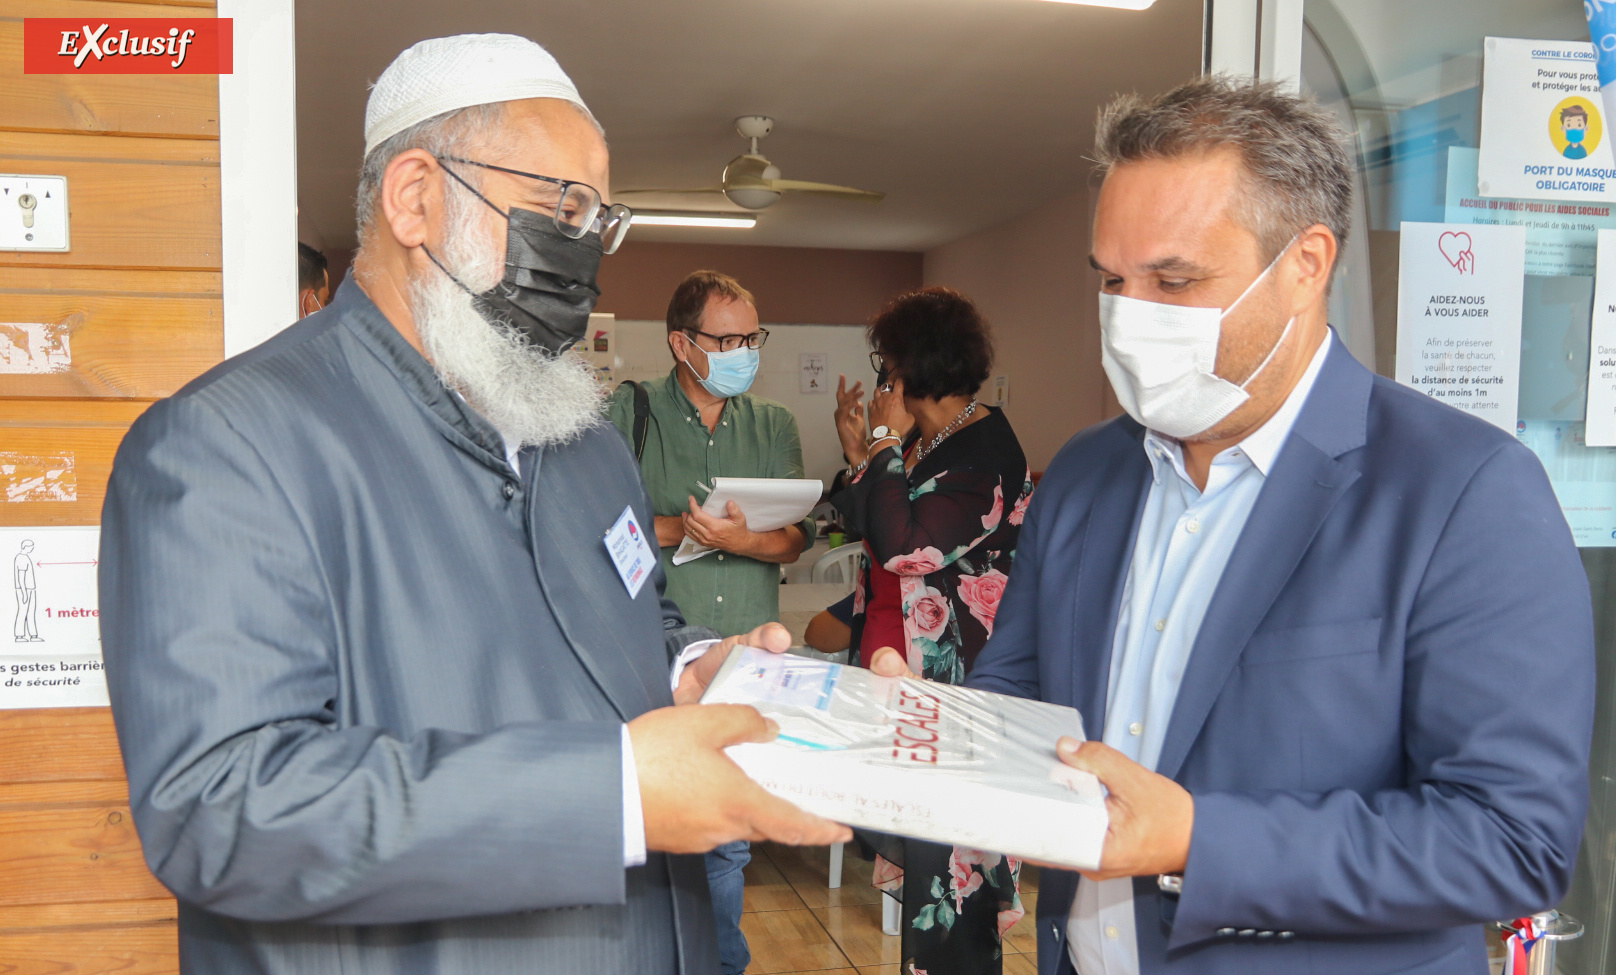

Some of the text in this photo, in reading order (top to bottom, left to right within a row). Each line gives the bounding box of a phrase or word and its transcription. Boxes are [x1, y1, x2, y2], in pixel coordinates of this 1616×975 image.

[1531, 49, 1561, 57] CONTRE
[1537, 68, 1557, 78] Pour
[1559, 70, 1577, 79] vous
[1531, 81, 1540, 89] et
[1542, 81, 1577, 92] protéger
[1580, 83, 1591, 92] les
[1524, 165, 1554, 175] PORT
[1557, 167, 1573, 176] DU
[1536, 180, 1605, 192] OBLIGATOIRE
[1460, 198, 1610, 217] ACCUEIL DU PUBLIC POUR LES AIDES SOCIALES
[1473, 216, 1500, 225] Horaires
[1533, 221, 1550, 230] Jeudi
[1551, 222, 1560, 230] de
[1561, 223, 1570, 231] 9h
[1429, 295, 1486, 304] AIDEZ-NOUS
[1424, 306, 1489, 317] À VOUS AIDER
[1426, 337, 1493, 348] Afin de préserver
[1421, 350, 1496, 360] la santé de chacun,
[1425, 363, 1492, 373] veuillez respecter
[1600, 359, 1616, 367] solu
[1411, 375, 1504, 384] la distance de sécurité
[1427, 388, 1488, 397] d'au moins 1m
[1471, 401, 1499, 409] attente
[45, 607, 100, 618] 1 mètre
[10, 662, 56, 675] gestes
[4, 677, 81, 687] de sécurité
[892, 690, 940, 765] ESCALES
